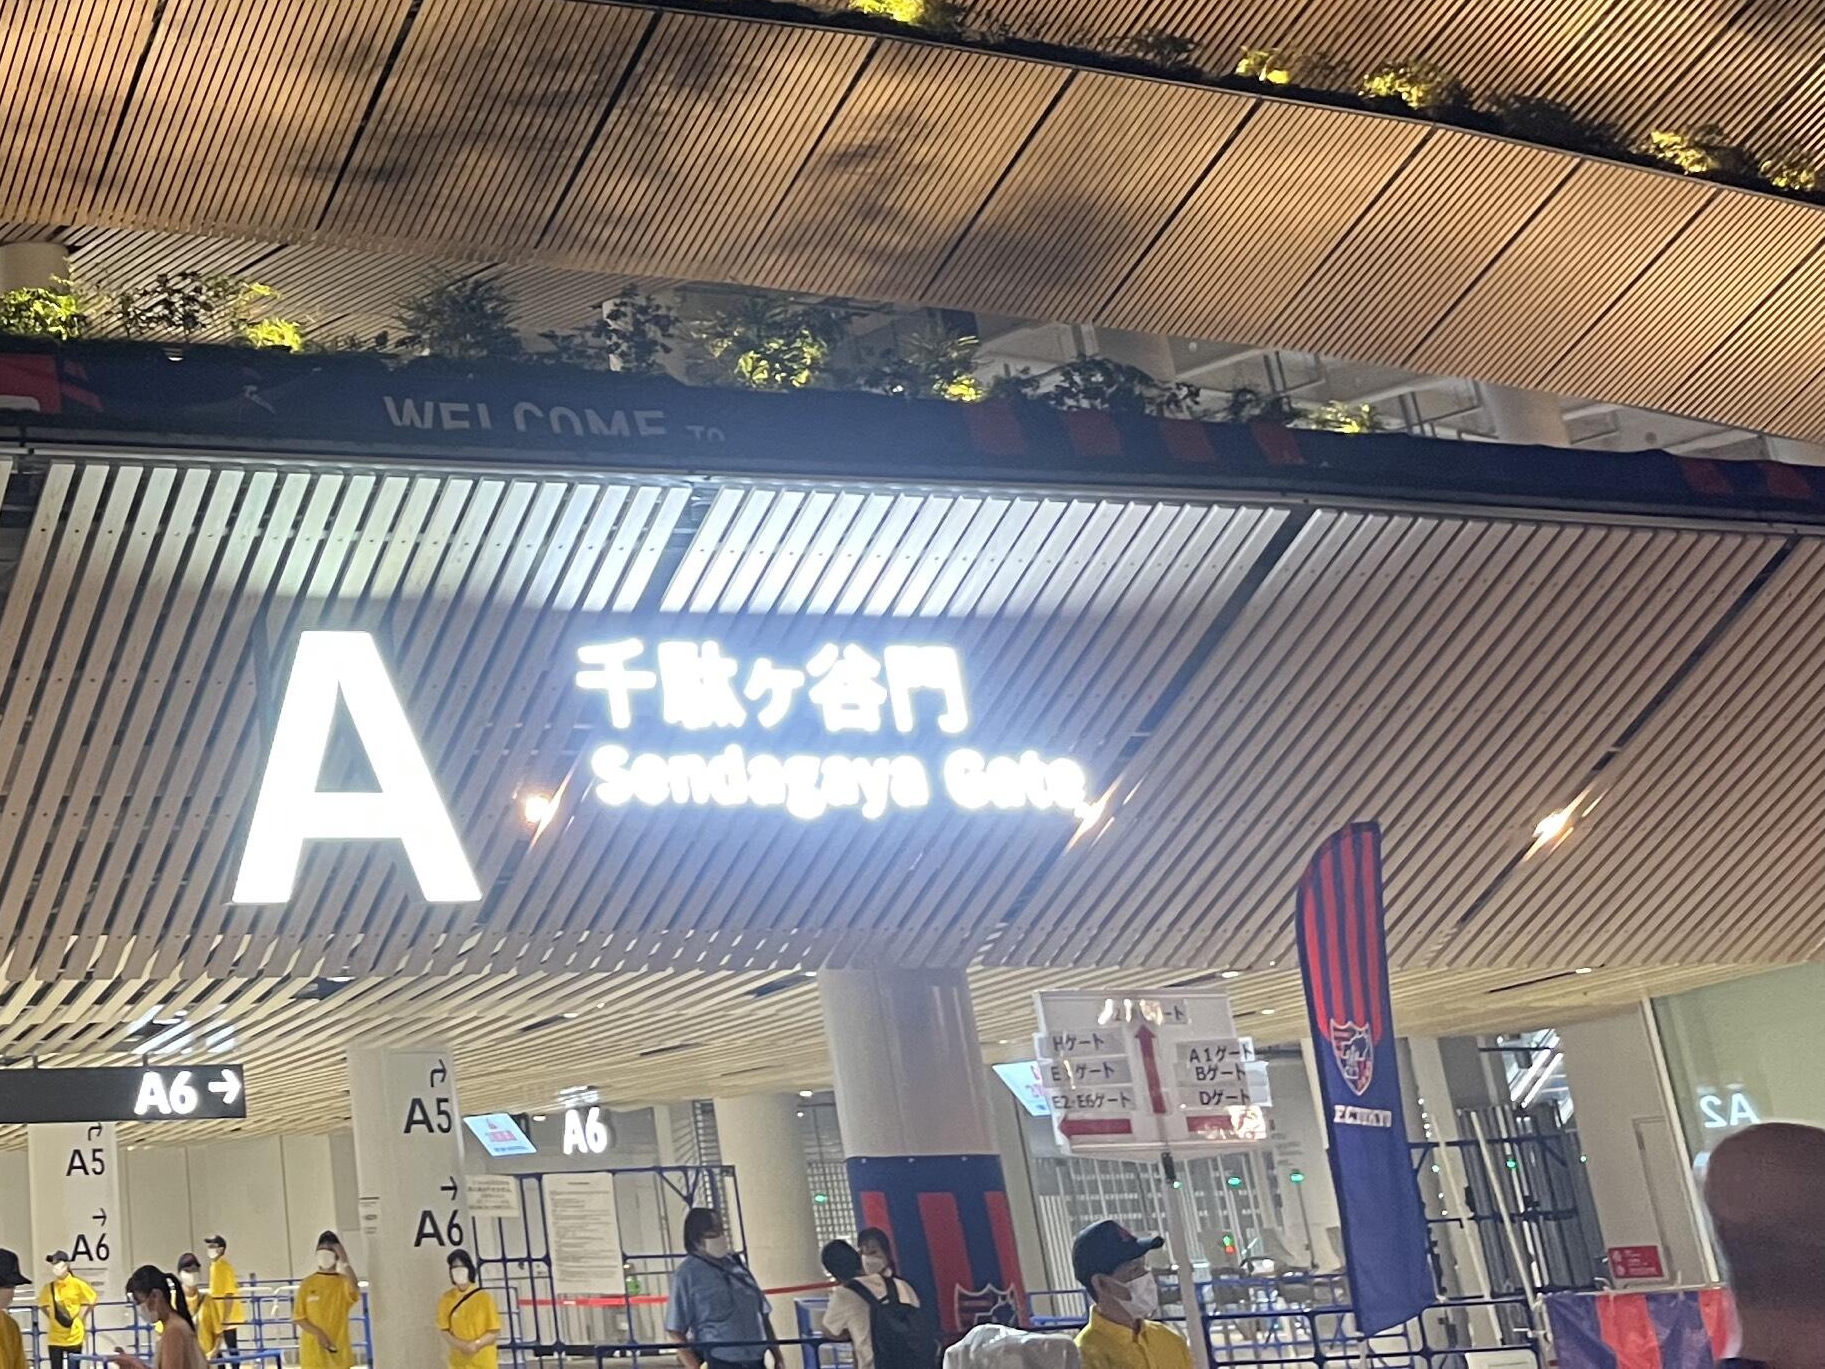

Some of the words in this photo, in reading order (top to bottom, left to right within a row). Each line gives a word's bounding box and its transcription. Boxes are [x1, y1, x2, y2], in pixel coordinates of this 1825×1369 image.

[231, 630, 484, 904] A
[591, 743, 930, 820] Sendagaya
[943, 748, 1086, 815] Gate
[1051, 1062, 1115, 1081] Eゲート
[1195, 1063, 1246, 1081] Bゲート
[133, 1070, 198, 1116] A6
[1199, 1088, 1251, 1105] Dゲート
[403, 1097, 452, 1134] A5
[562, 1106, 608, 1155] A6
[66, 1148, 105, 1177] A5
[414, 1209, 464, 1247] A6
[71, 1233, 110, 1262] A6
